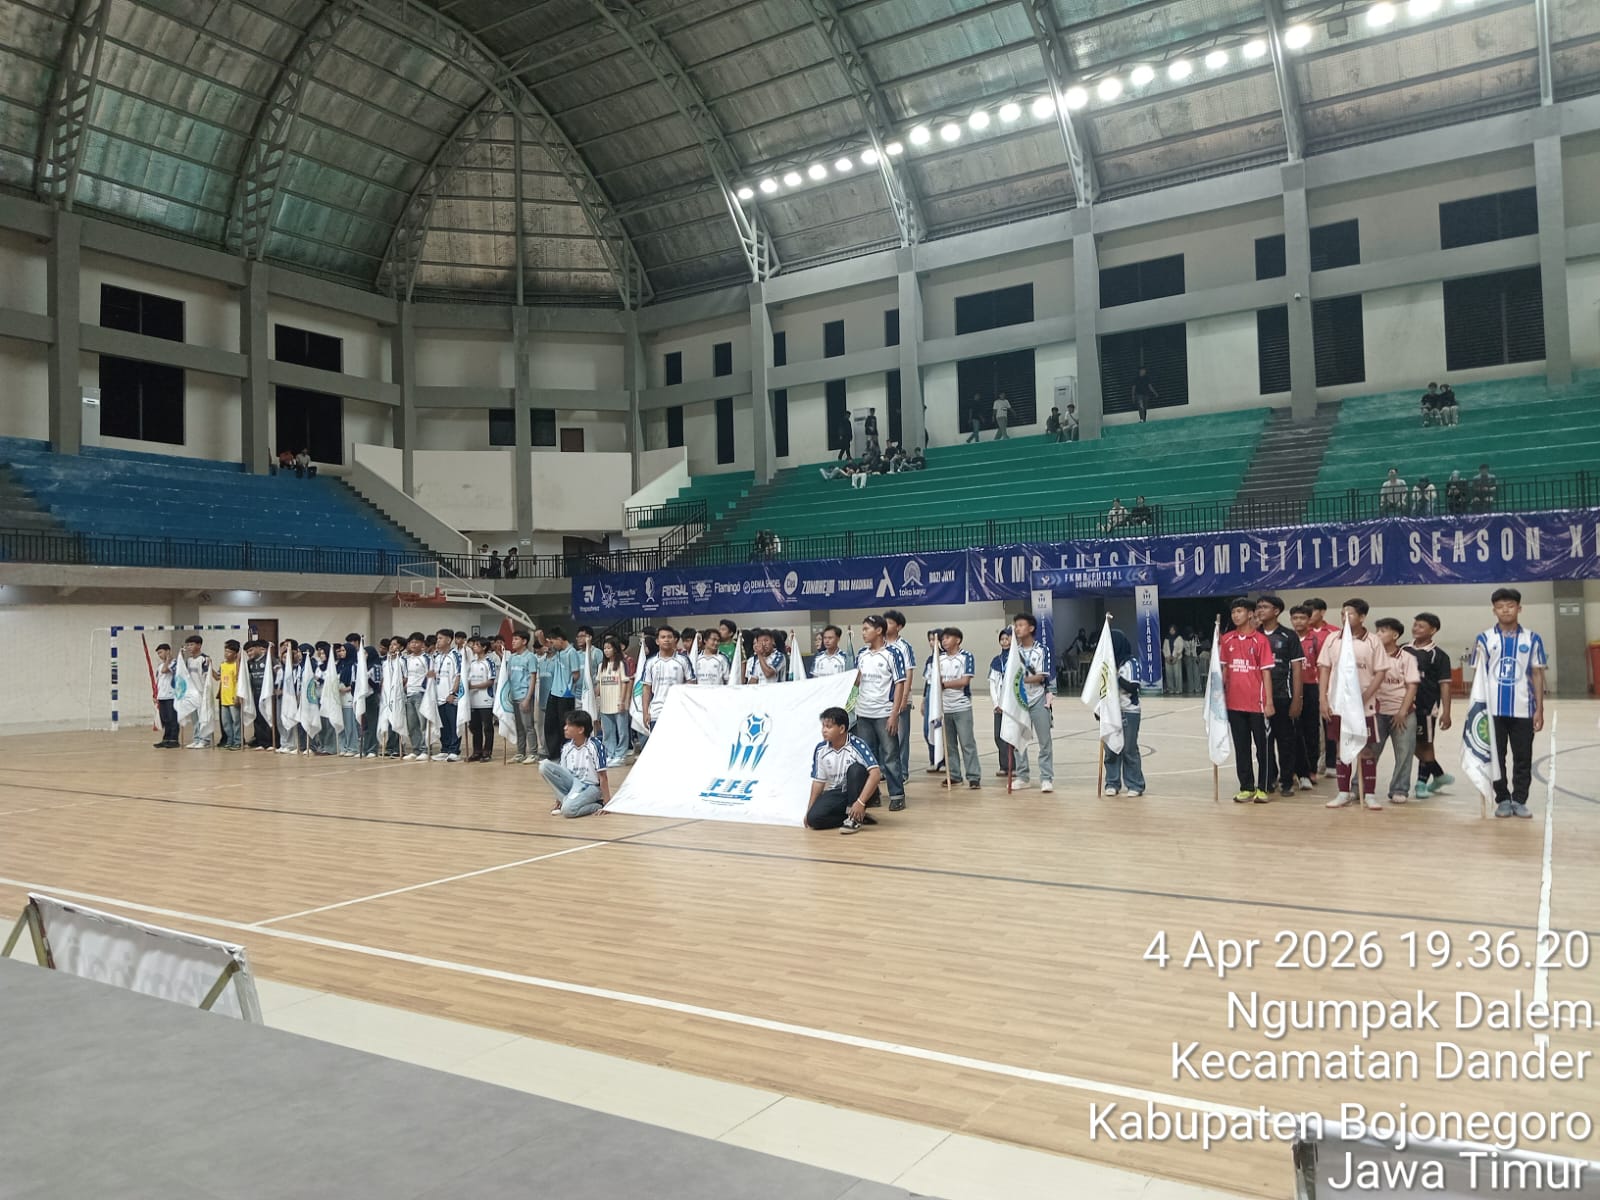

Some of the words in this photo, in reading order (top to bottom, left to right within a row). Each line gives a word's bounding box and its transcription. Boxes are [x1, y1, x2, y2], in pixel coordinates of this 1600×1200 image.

[1174, 533, 1384, 575] COMPETITION
[1409, 527, 1541, 565] SEASON
[661, 584, 689, 597] FUTSAL
[709, 778, 759, 794] FFC
